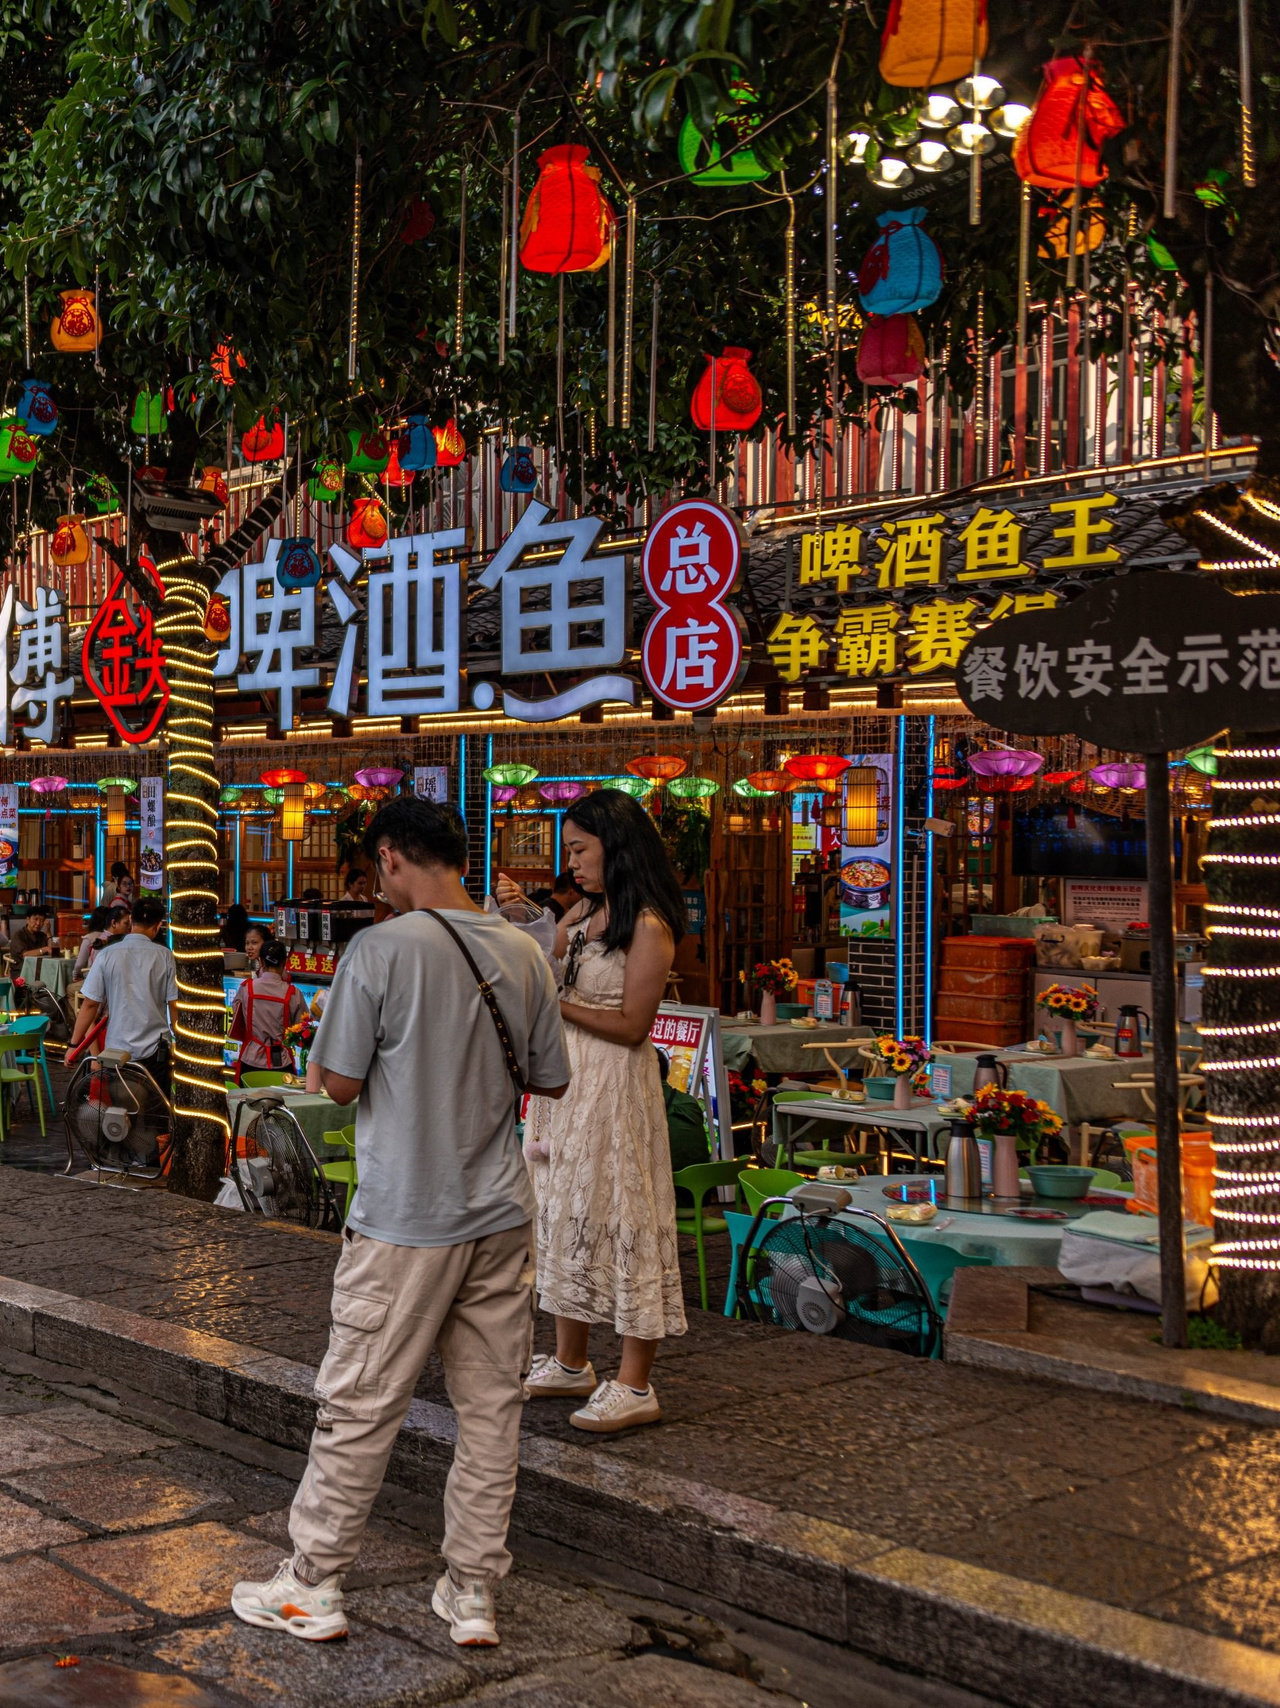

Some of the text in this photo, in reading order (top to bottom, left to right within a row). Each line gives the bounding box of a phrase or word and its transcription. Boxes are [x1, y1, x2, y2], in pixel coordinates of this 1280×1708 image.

[901, 182, 937, 201] 400W
[799, 492, 1122, 593] 啤酒鱼王
[214, 499, 637, 731] 啤酒鱼
[660, 521, 720, 691] 总店
[963, 627, 1280, 702] 餐饮安全示范
[289, 953, 334, 973] 免费送
[649, 1017, 700, 1043] 过的餐厅
